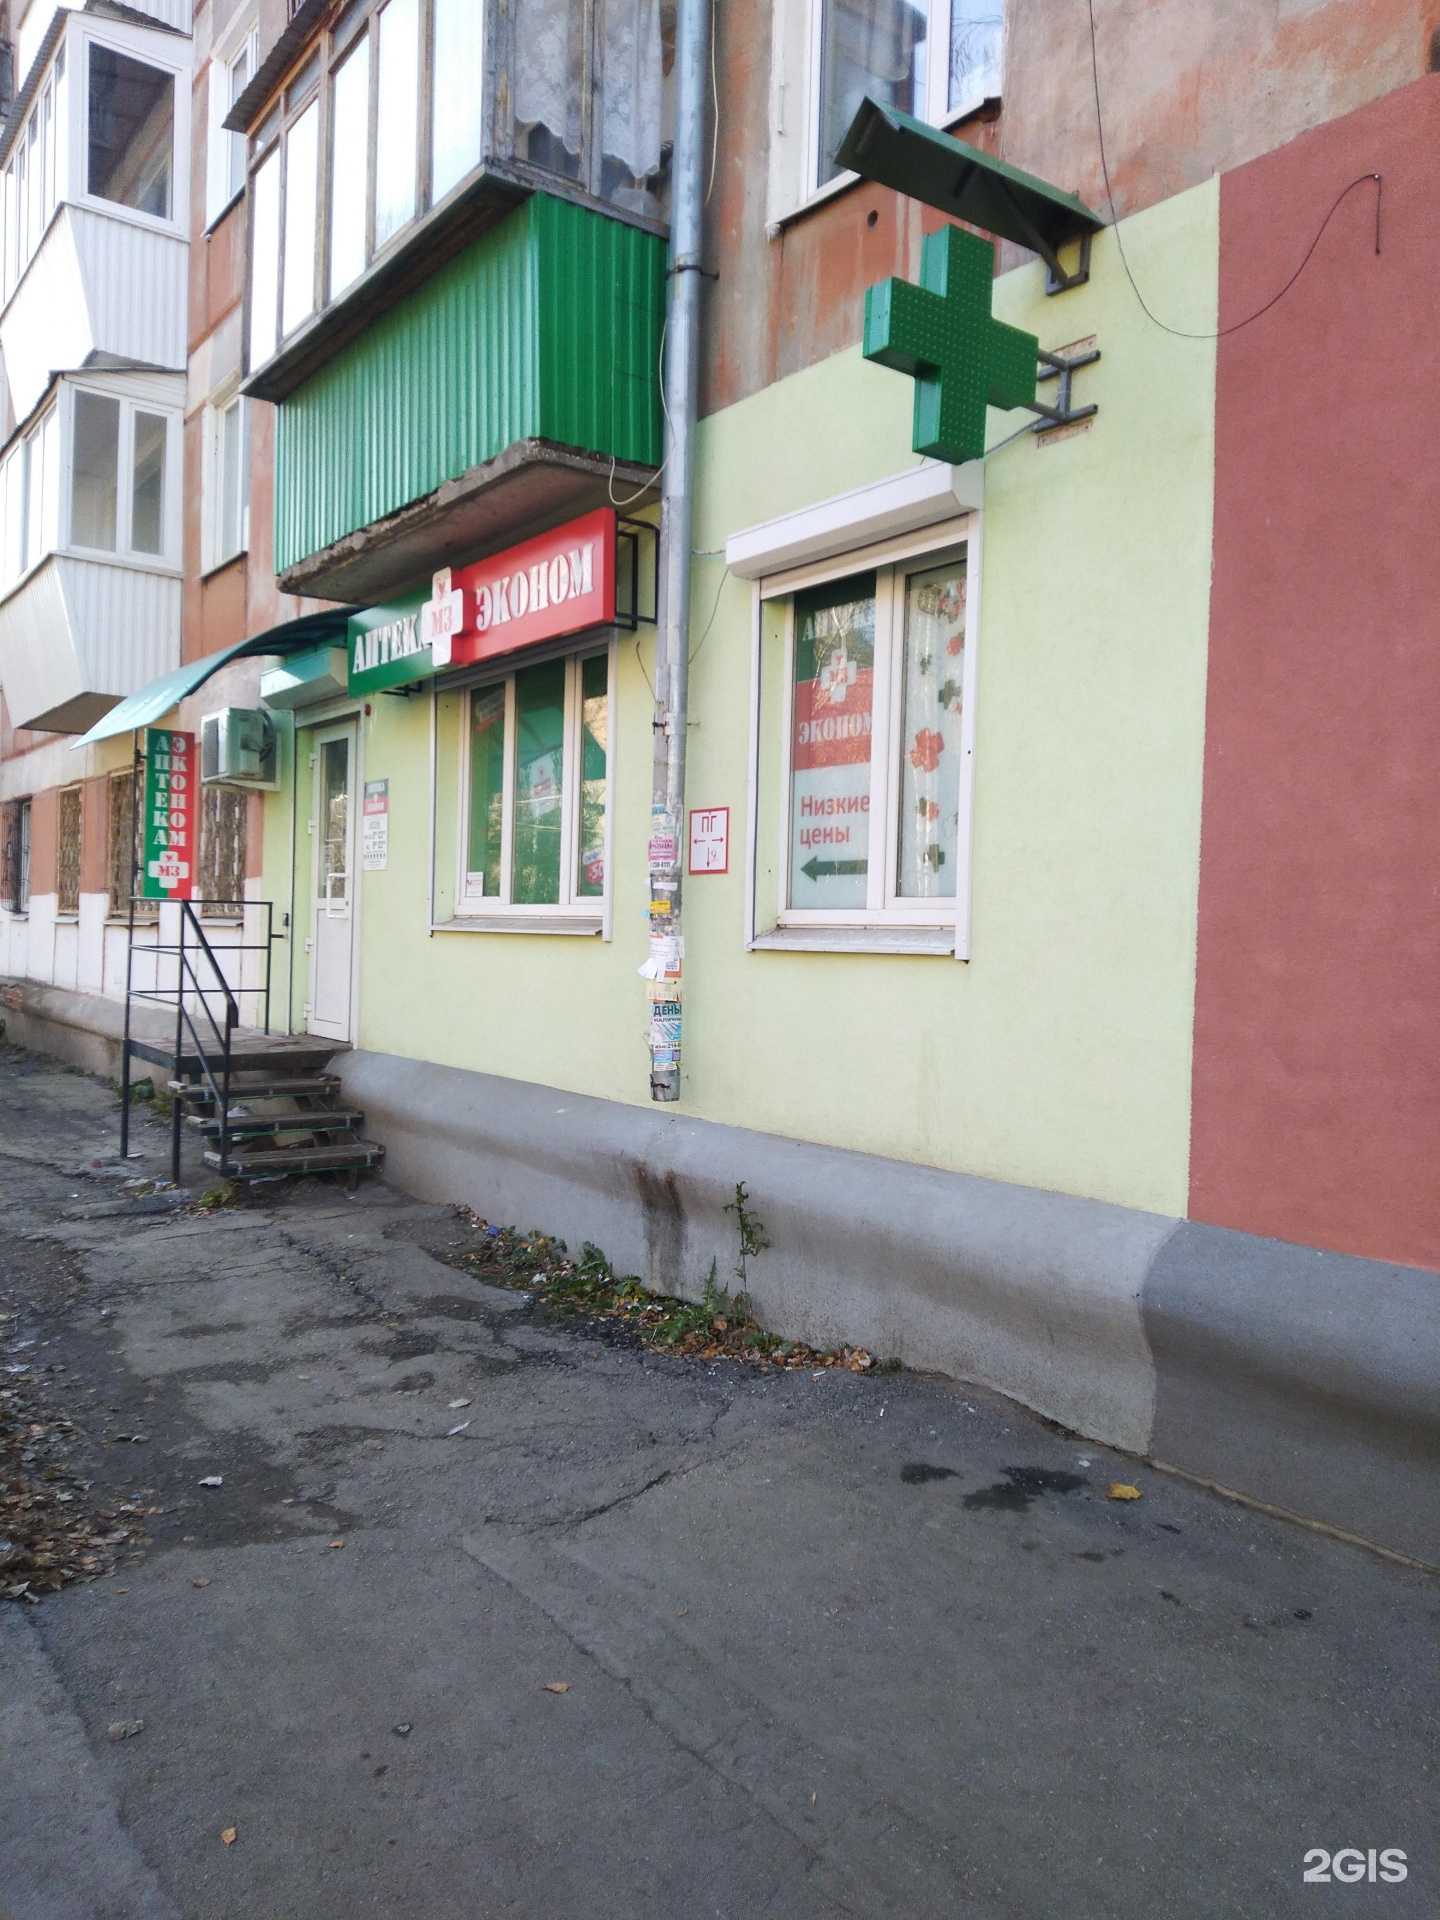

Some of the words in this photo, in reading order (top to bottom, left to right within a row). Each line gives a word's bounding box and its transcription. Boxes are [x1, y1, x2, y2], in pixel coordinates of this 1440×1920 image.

[352, 613, 432, 674] АПТЕК
[476, 543, 595, 631] ЭКОНОМ
[152, 735, 169, 846] АПТЕКА
[169, 735, 188, 847] ЭКОНОМ
[701, 815, 717, 833] ПГ
[800, 794, 871, 817] Низкие
[799, 826, 850, 850] цены
